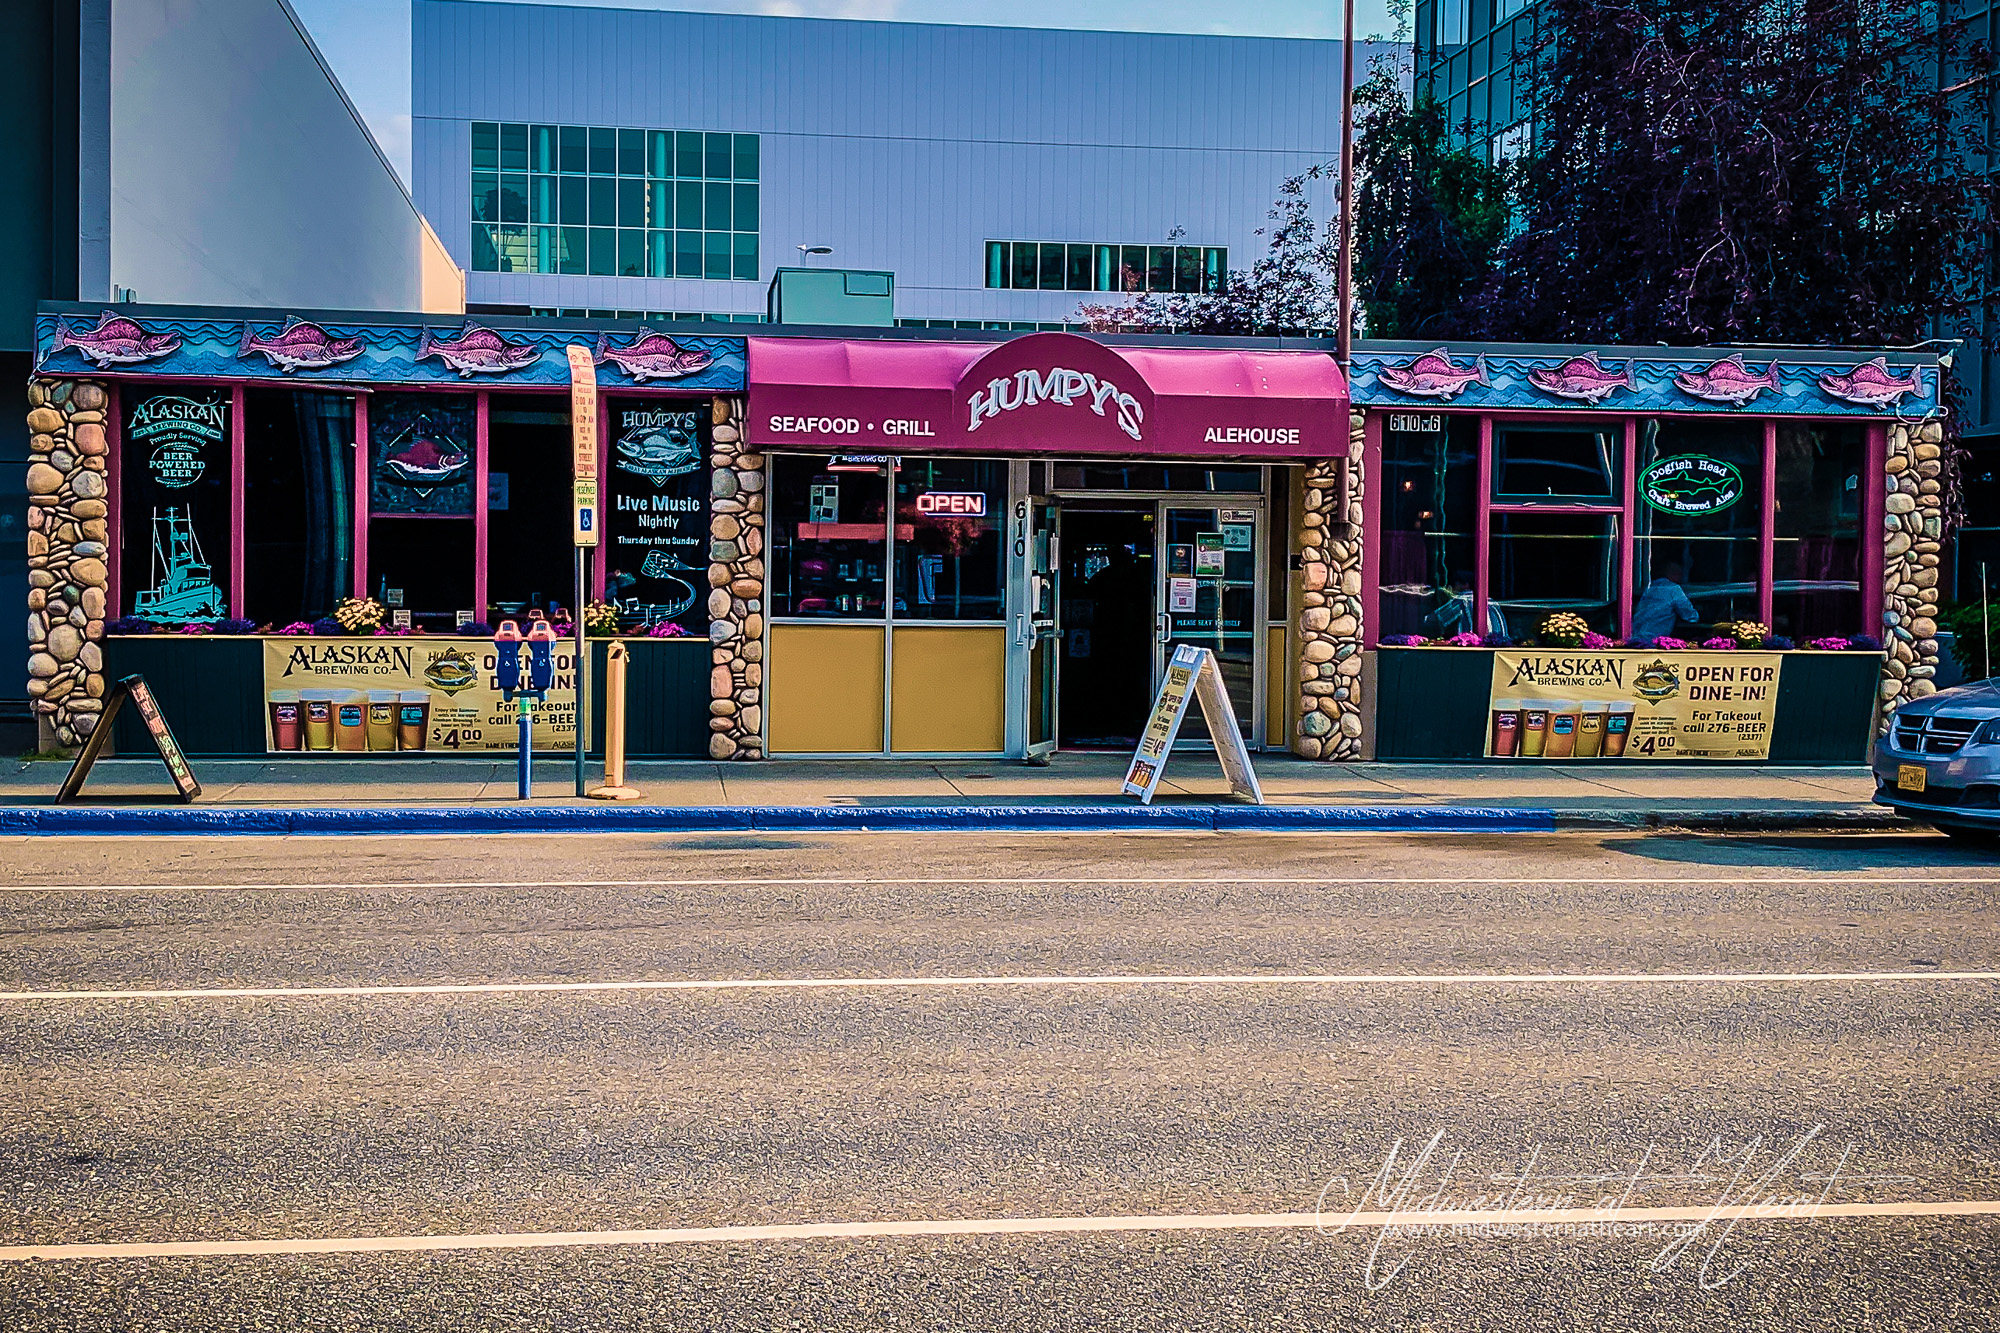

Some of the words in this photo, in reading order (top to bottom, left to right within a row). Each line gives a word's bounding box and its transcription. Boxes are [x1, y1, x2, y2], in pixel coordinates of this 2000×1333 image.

[967, 367, 1144, 440] HUMPY'S
[128, 404, 226, 430] ALASKAN
[621, 411, 697, 430] HUMPY'S
[769, 416, 860, 434] SEAFOOD
[882, 420, 936, 437] GRILL
[149, 432, 177, 446] Proudly
[179, 432, 207, 447] Serving
[1204, 427, 1300, 445] ALEHOUSE
[163, 452, 193, 460] BEER
[149, 461, 206, 469] POWERED
[1649, 459, 1693, 480] Dogfish
[1698, 459, 1727, 477] Head
[162, 469, 192, 477] BEER
[576, 486, 595, 495] RESERVED
[577, 497, 594, 505] PARKING
[617, 495, 648, 512] Live
[653, 495, 701, 512] Music
[916, 494, 982, 513] OPEN
[1648, 489, 1671, 507] Craft
[1675, 500, 1711, 511] Brewed
[1715, 489, 1735, 506] Ales
[639, 514, 680, 530] Nightly
[1015, 501, 1026, 557] 610
[617, 535, 653, 546] Thursday
[654, 536, 671, 545] thru
[671, 536, 700, 547] Sunday
[282, 645, 414, 679] ALASKAN
[315, 665, 369, 675] BREWING
[373, 666, 392, 675] CO.
[1507, 658, 1626, 690] ALASKAN
[1686, 666, 1735, 682] OPEN
[1740, 667, 1774, 682] FOR
[1537, 677, 1584, 686] BREWING
[1588, 677, 1605, 686] CO.
[1689, 686, 1767, 700] DINE-IN!
[496, 702, 517, 711] For
[531, 701, 576, 711] akeout
[488, 714, 512, 725] call
[1692, 711, 1712, 721] For
[1714, 711, 1762, 721] Takeout
[1683, 723, 1705, 733] call
[1707, 723, 1767, 733] 276-BEER
[1738, 733, 1763, 741] (2337)
